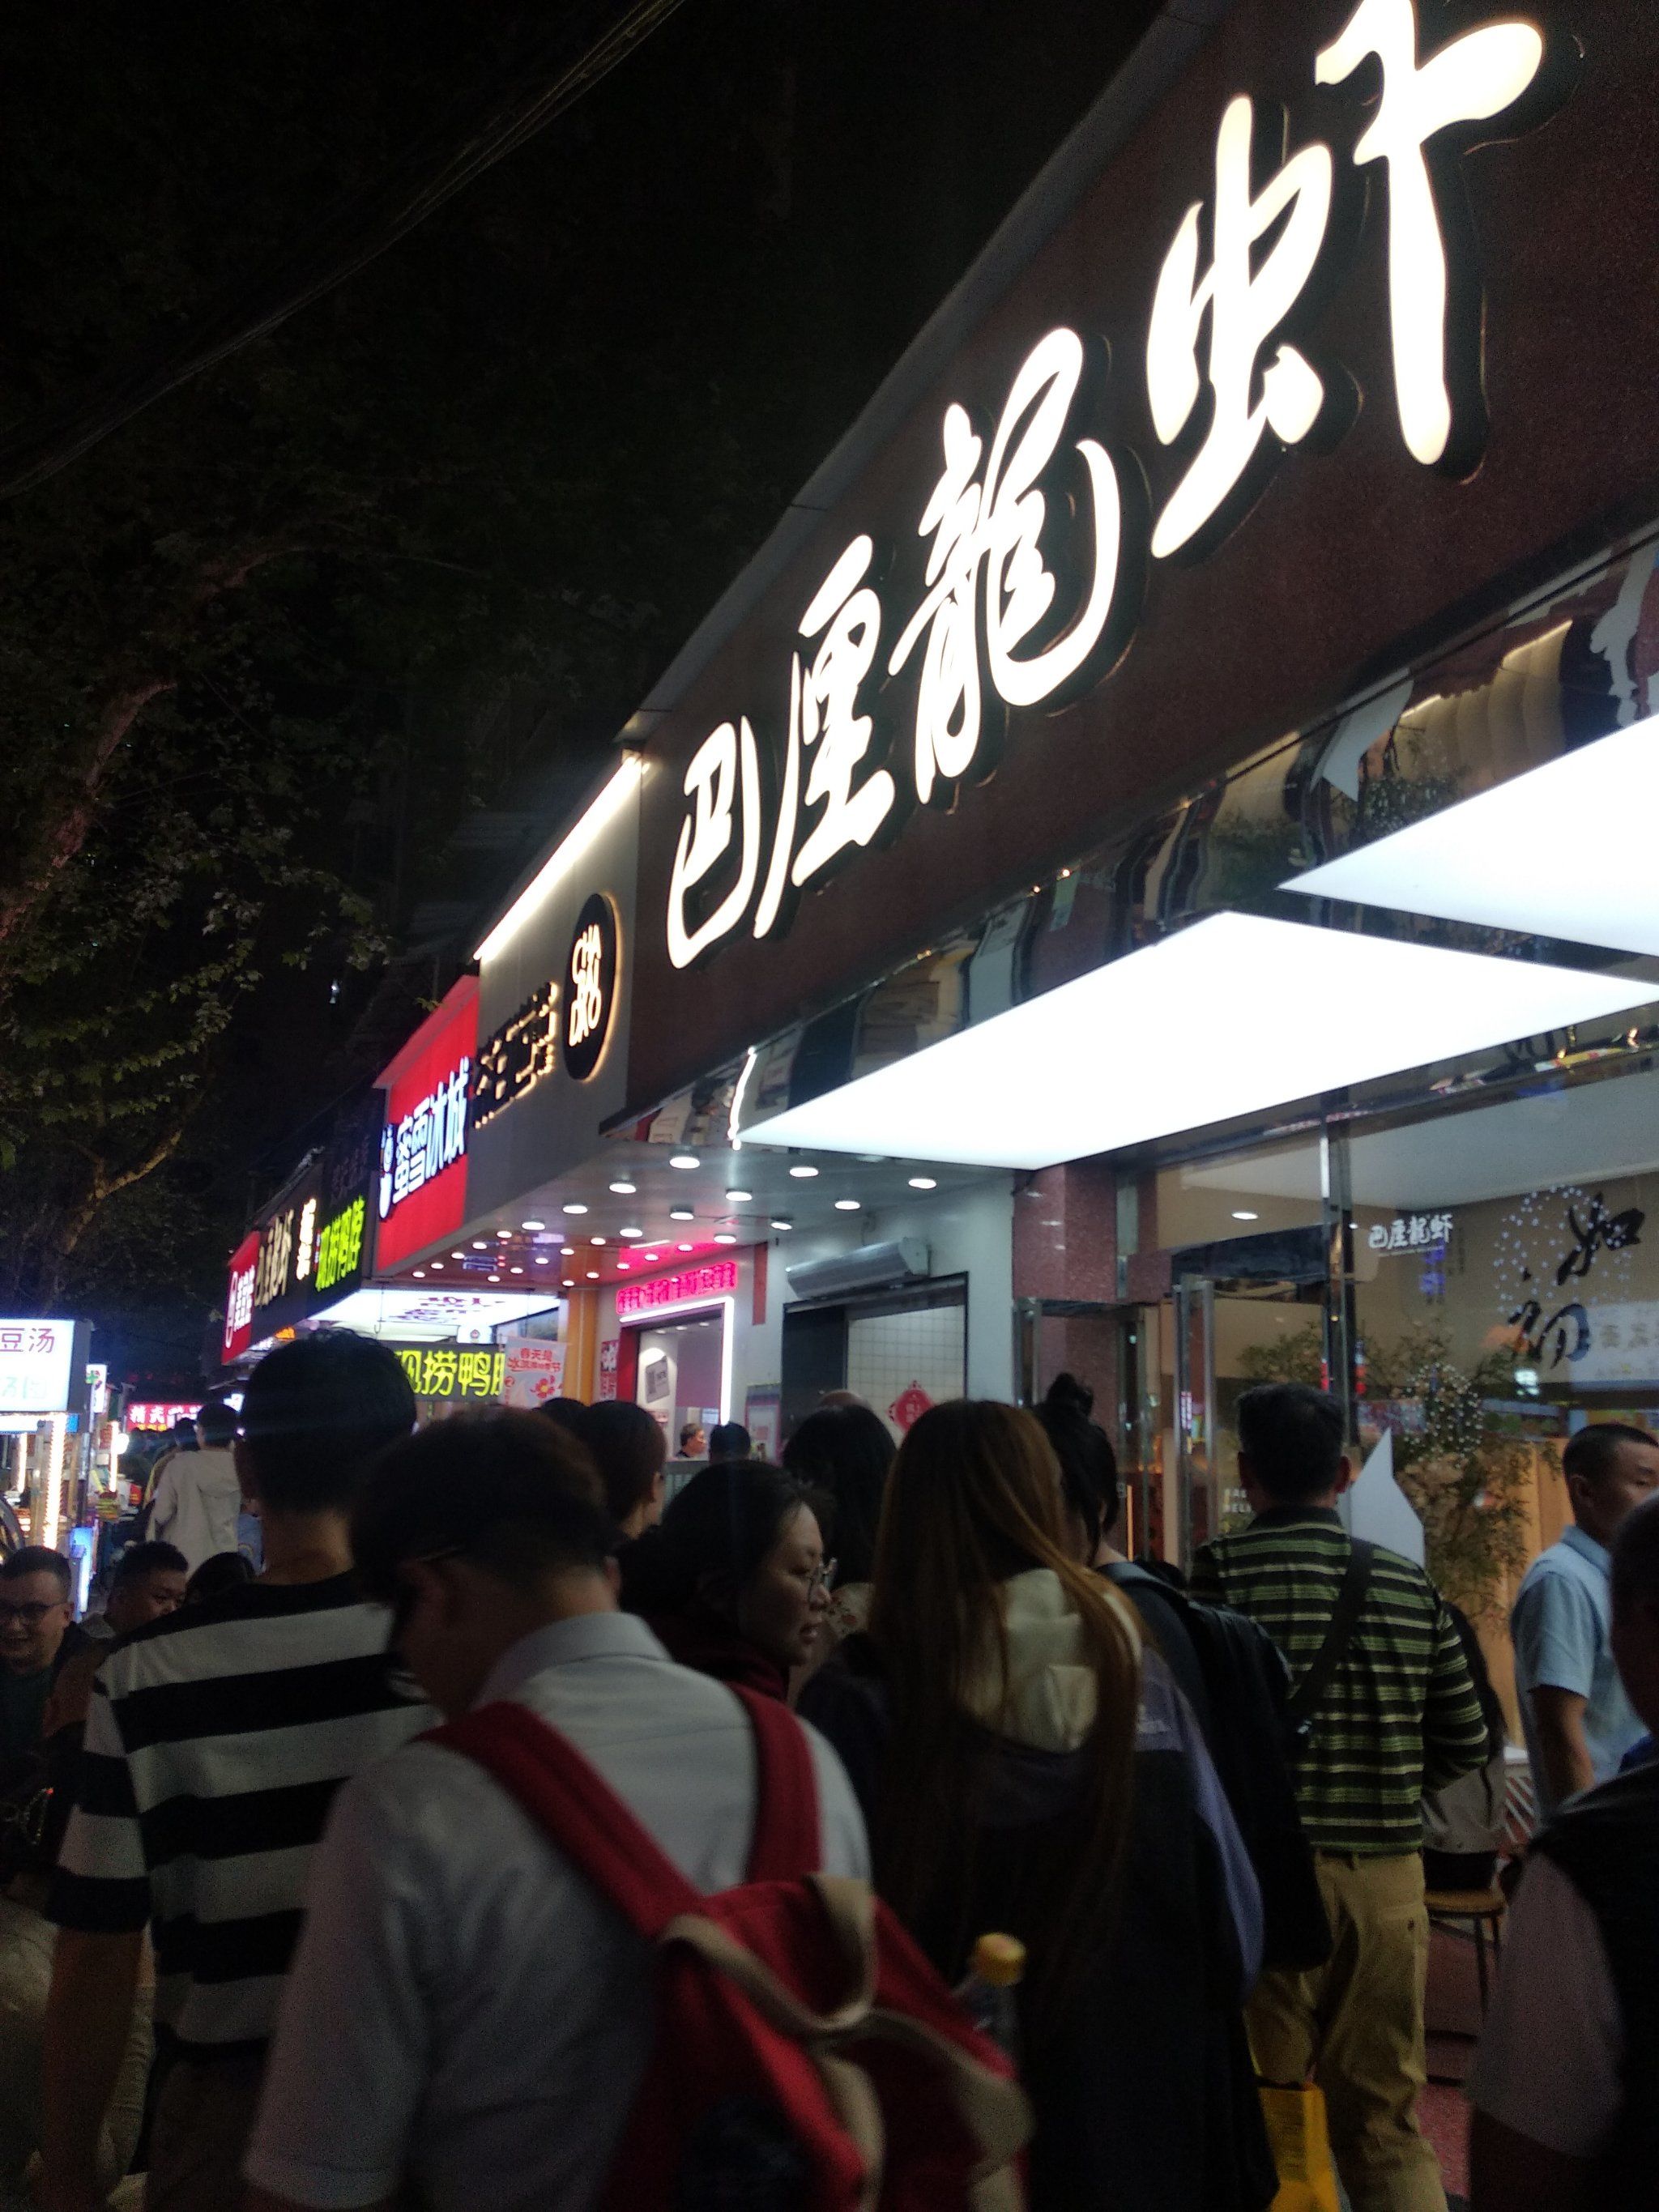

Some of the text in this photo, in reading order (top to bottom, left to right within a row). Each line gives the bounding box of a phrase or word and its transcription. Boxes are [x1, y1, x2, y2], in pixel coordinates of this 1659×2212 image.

[572, 924, 601, 983] CHA
[392, 1056, 469, 1204] 蜜雪冰城
[0, 1328, 55, 1353] 豆汤
